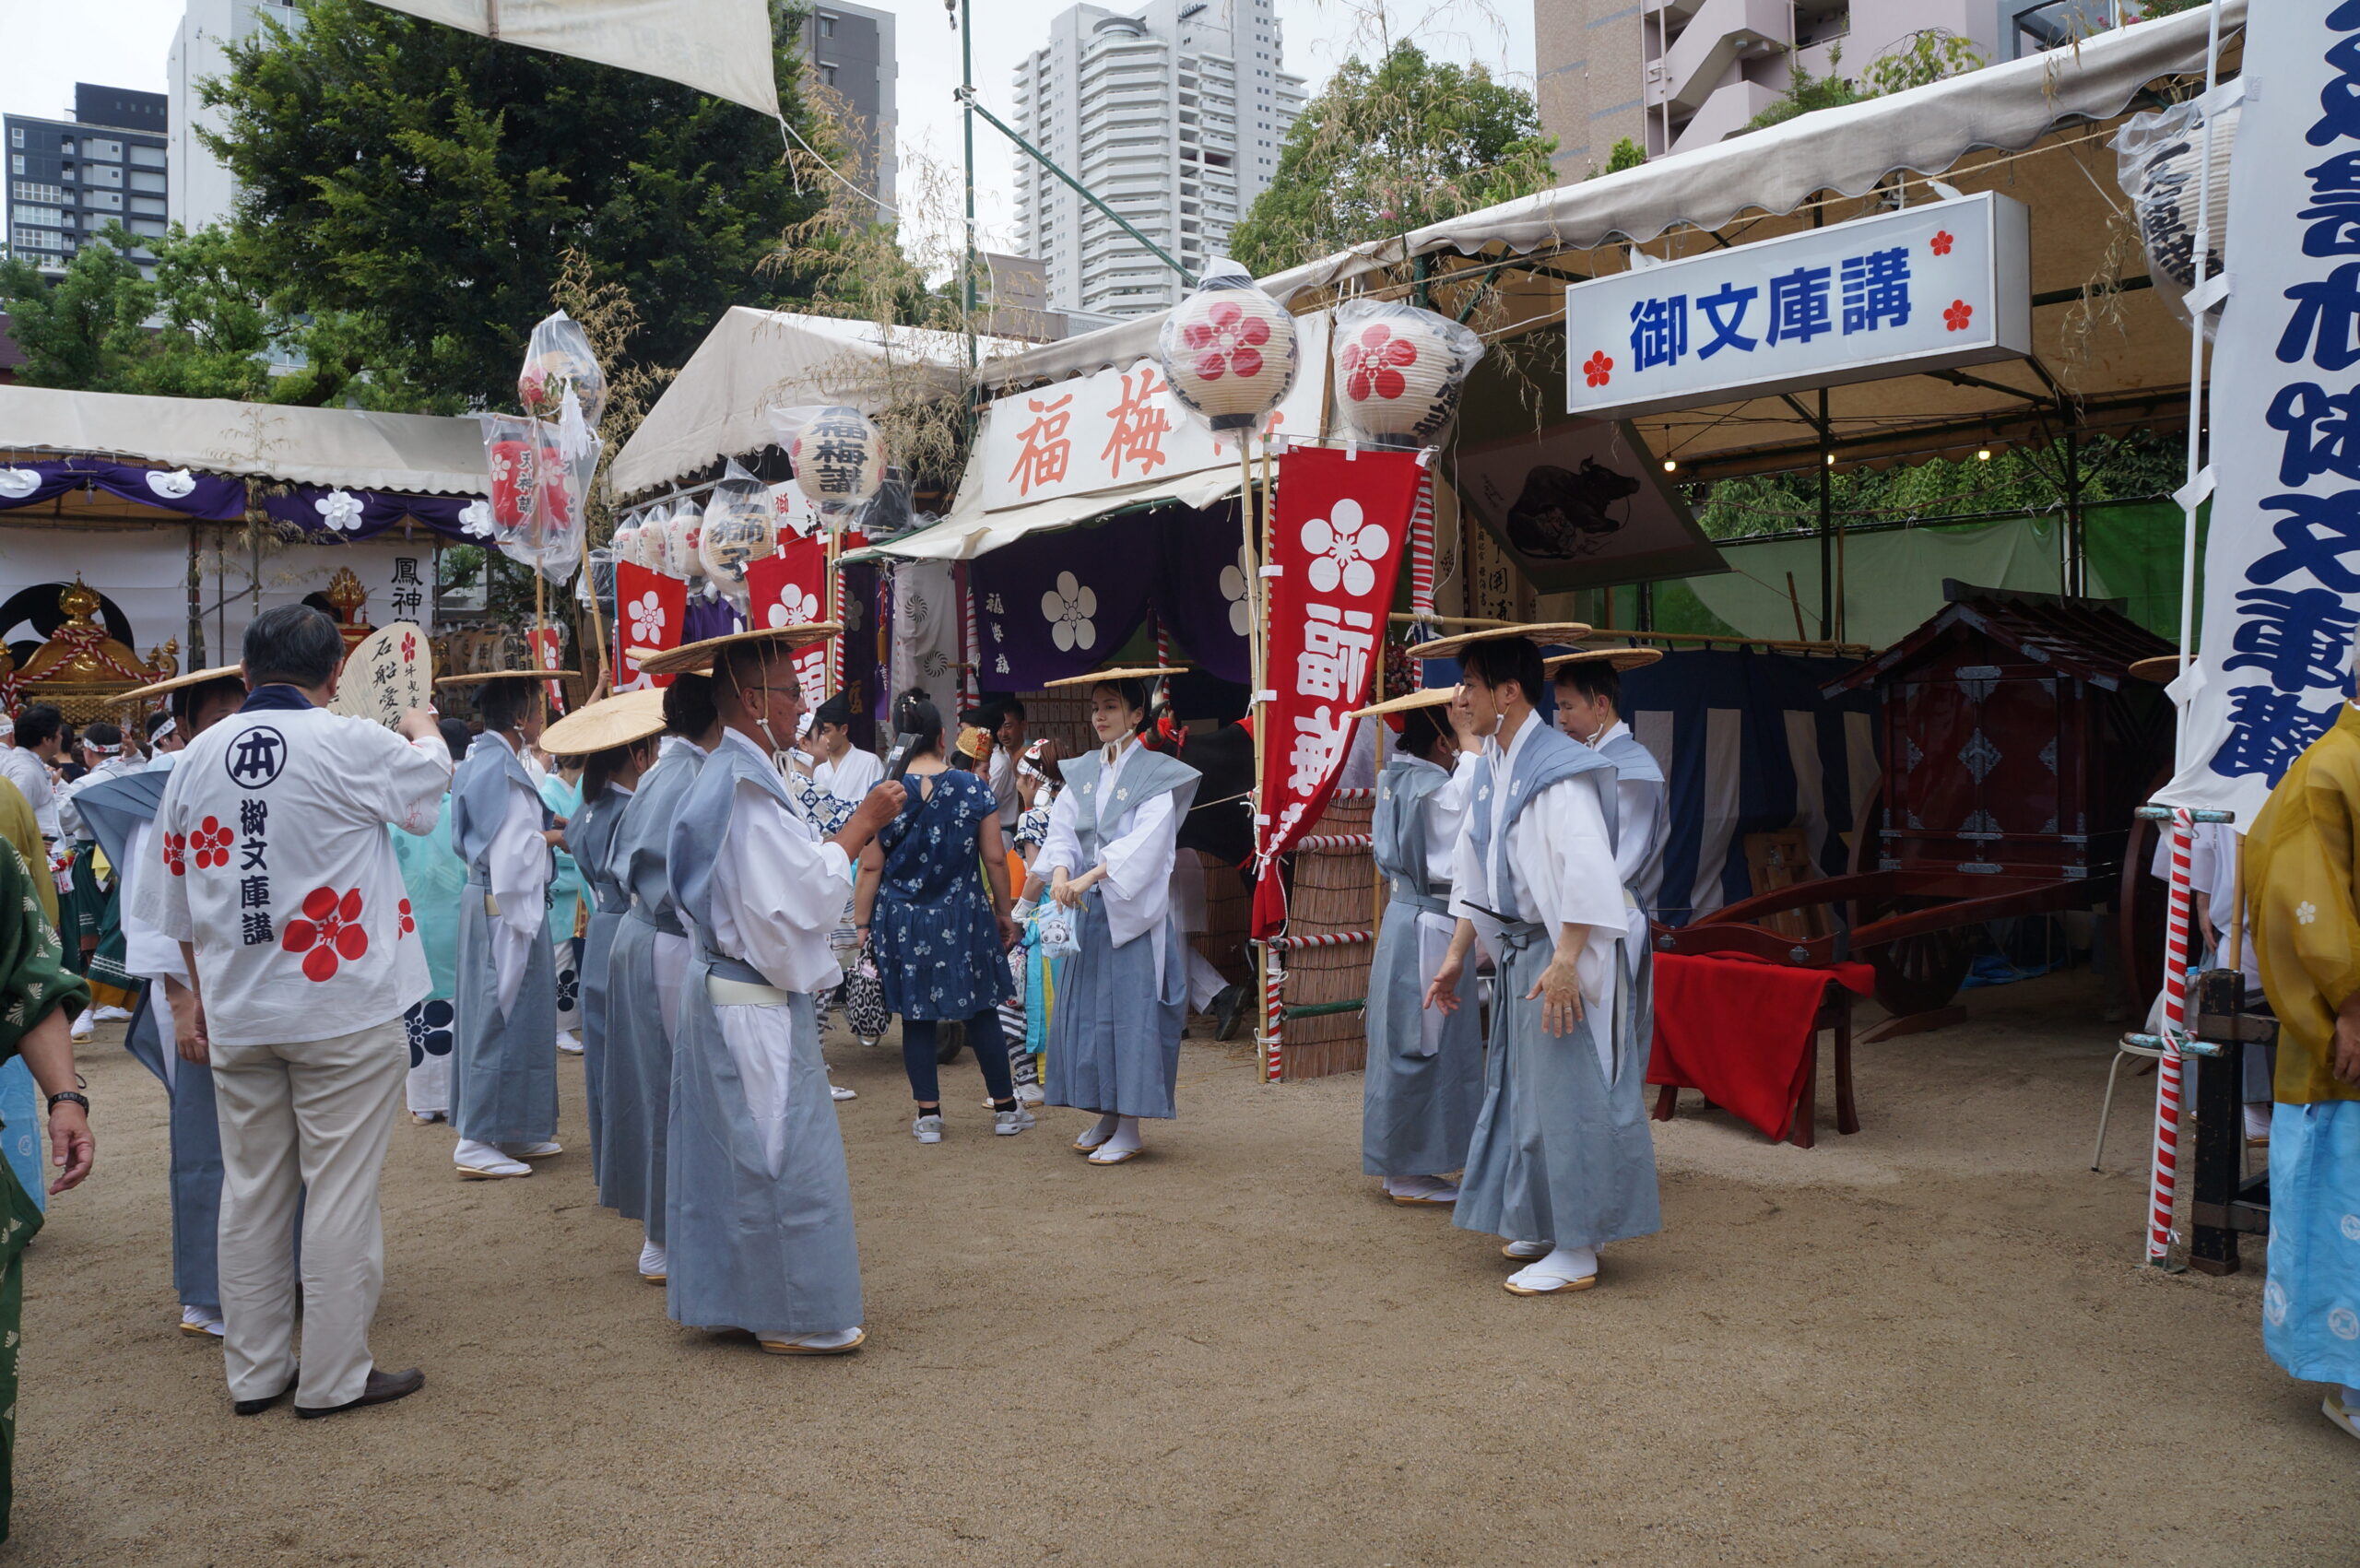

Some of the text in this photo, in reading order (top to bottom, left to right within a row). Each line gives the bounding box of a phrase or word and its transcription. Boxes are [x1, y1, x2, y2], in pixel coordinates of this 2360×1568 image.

[1629, 246, 1912, 372] 御文庫講
[811, 421, 868, 494] 福梅講
[1008, 368, 1284, 497] 福梅
[391, 557, 424, 625] 鳳神
[232, 730, 280, 780] 本
[241, 798, 275, 946] 御文庫講
